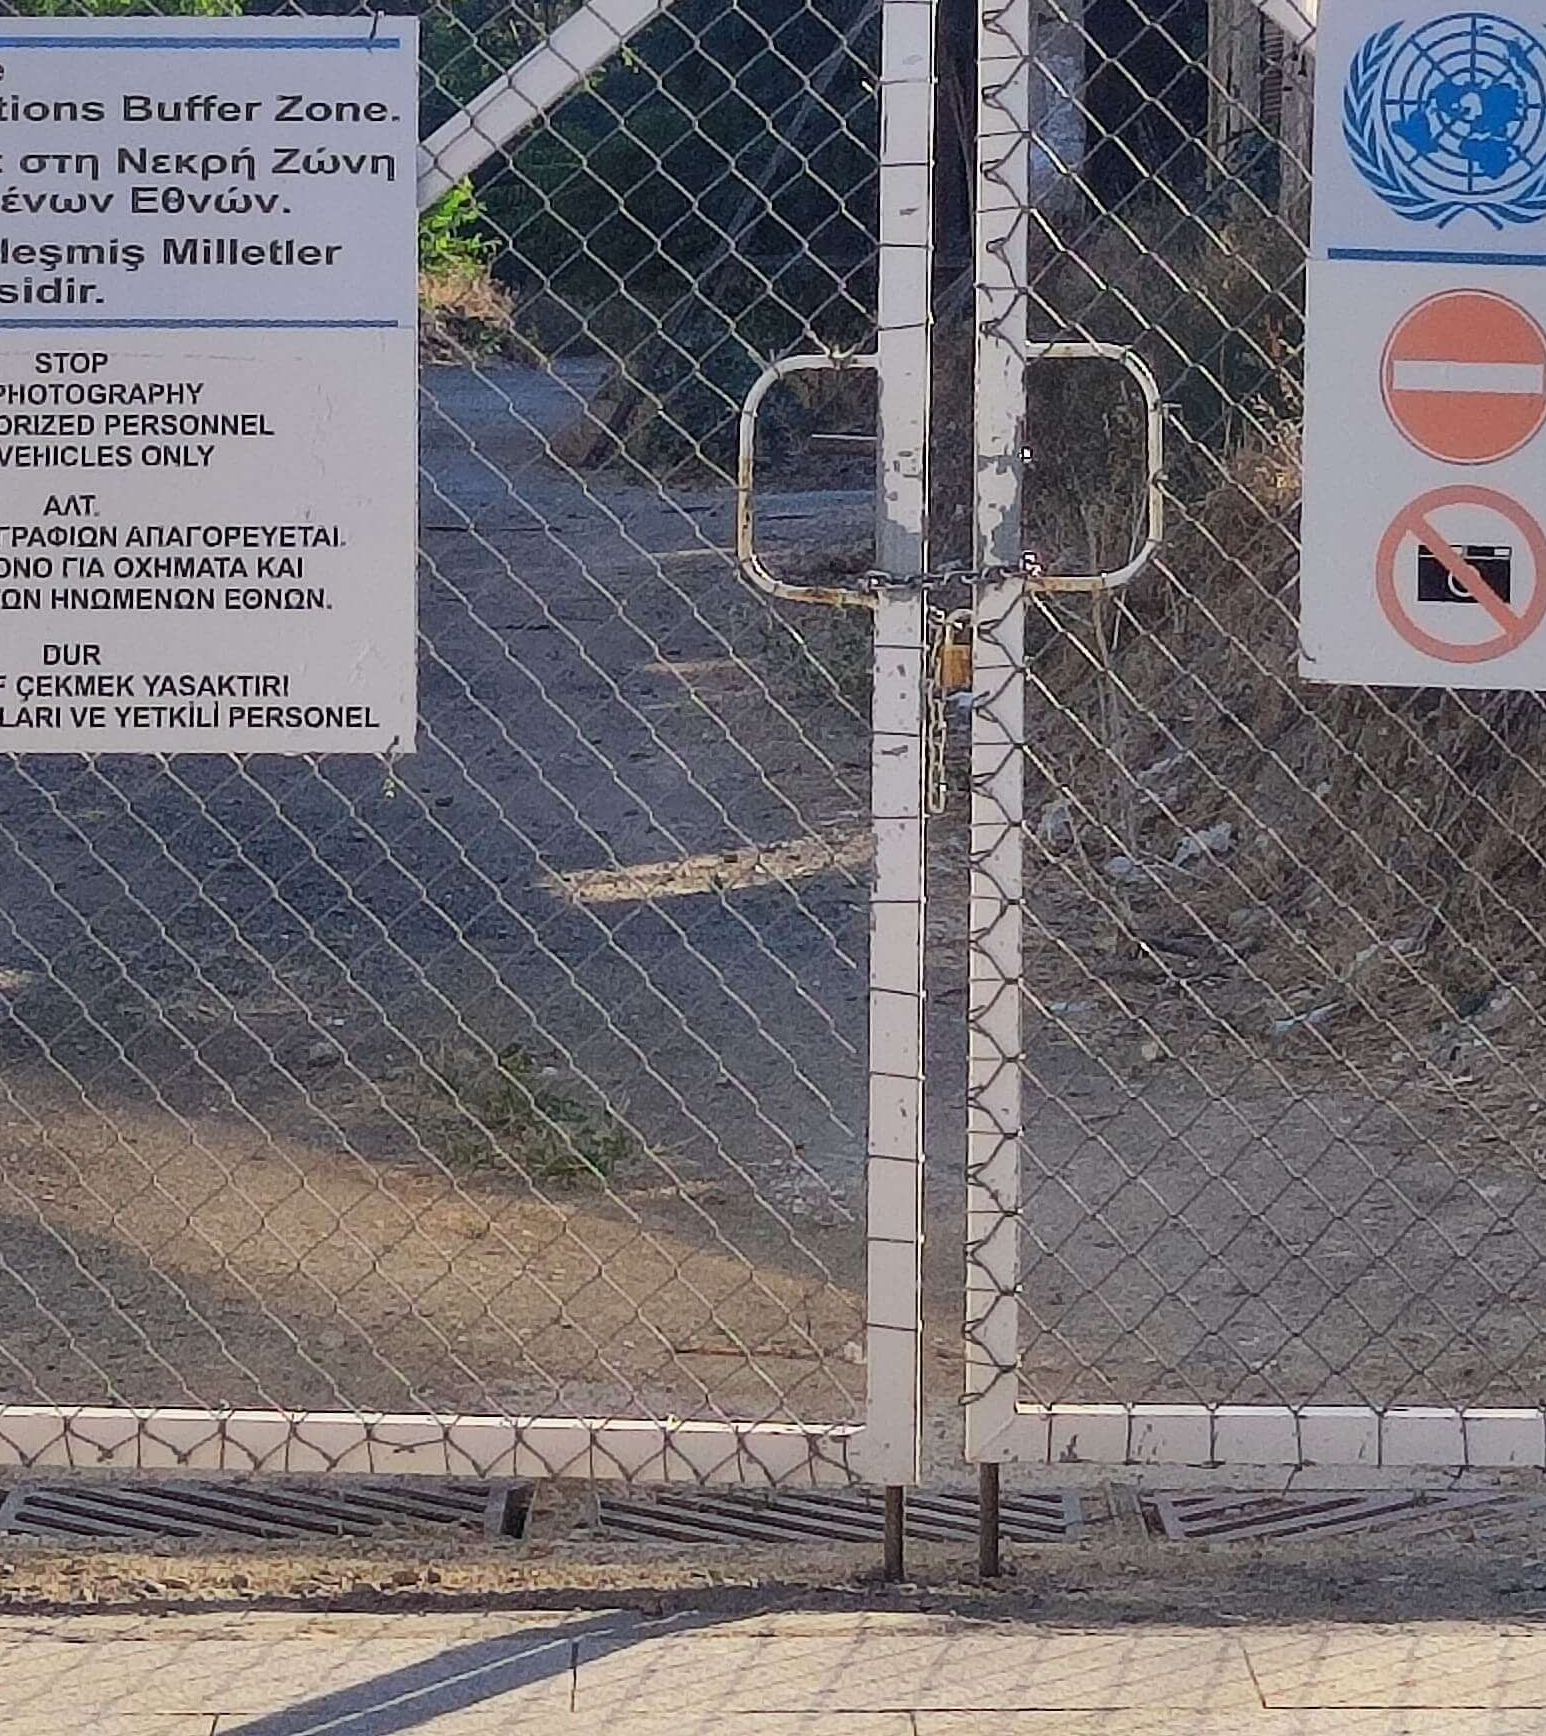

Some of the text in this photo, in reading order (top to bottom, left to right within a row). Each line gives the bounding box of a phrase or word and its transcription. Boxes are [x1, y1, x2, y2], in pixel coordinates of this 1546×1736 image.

[123, 95, 262, 121] Buffer
[275, 95, 400, 122] Zone.
[20, 154, 98, 181] στη
[118, 147, 255, 181] Νεκρή
[272, 147, 394, 181] Ζώνη
[132, 187, 291, 213] Εθνών.
[164, 239, 342, 265] Milletler
[35, 353, 108, 373] STOP
[105, 414, 275, 435] PERSONNEL
[142, 445, 215, 467] ONLY
[63, 557, 104, 578] ΓΙΑ
[114, 557, 248, 578] ΟΧΗΜΑΤΑ
[258, 557, 302, 578] ΚΑΙ
[52, 588, 214, 609] ΗΝΩΜΕΝΩΝ
[226, 588, 332, 609] ΕΘΝΩΝ.
[44, 644, 101, 665] DUR
[17, 675, 134, 702] ÇEKMEK
[70, 707, 106, 728] VE
[115, 701, 218, 728] YETKİLİ
[229, 706, 380, 728] PERSONEL
